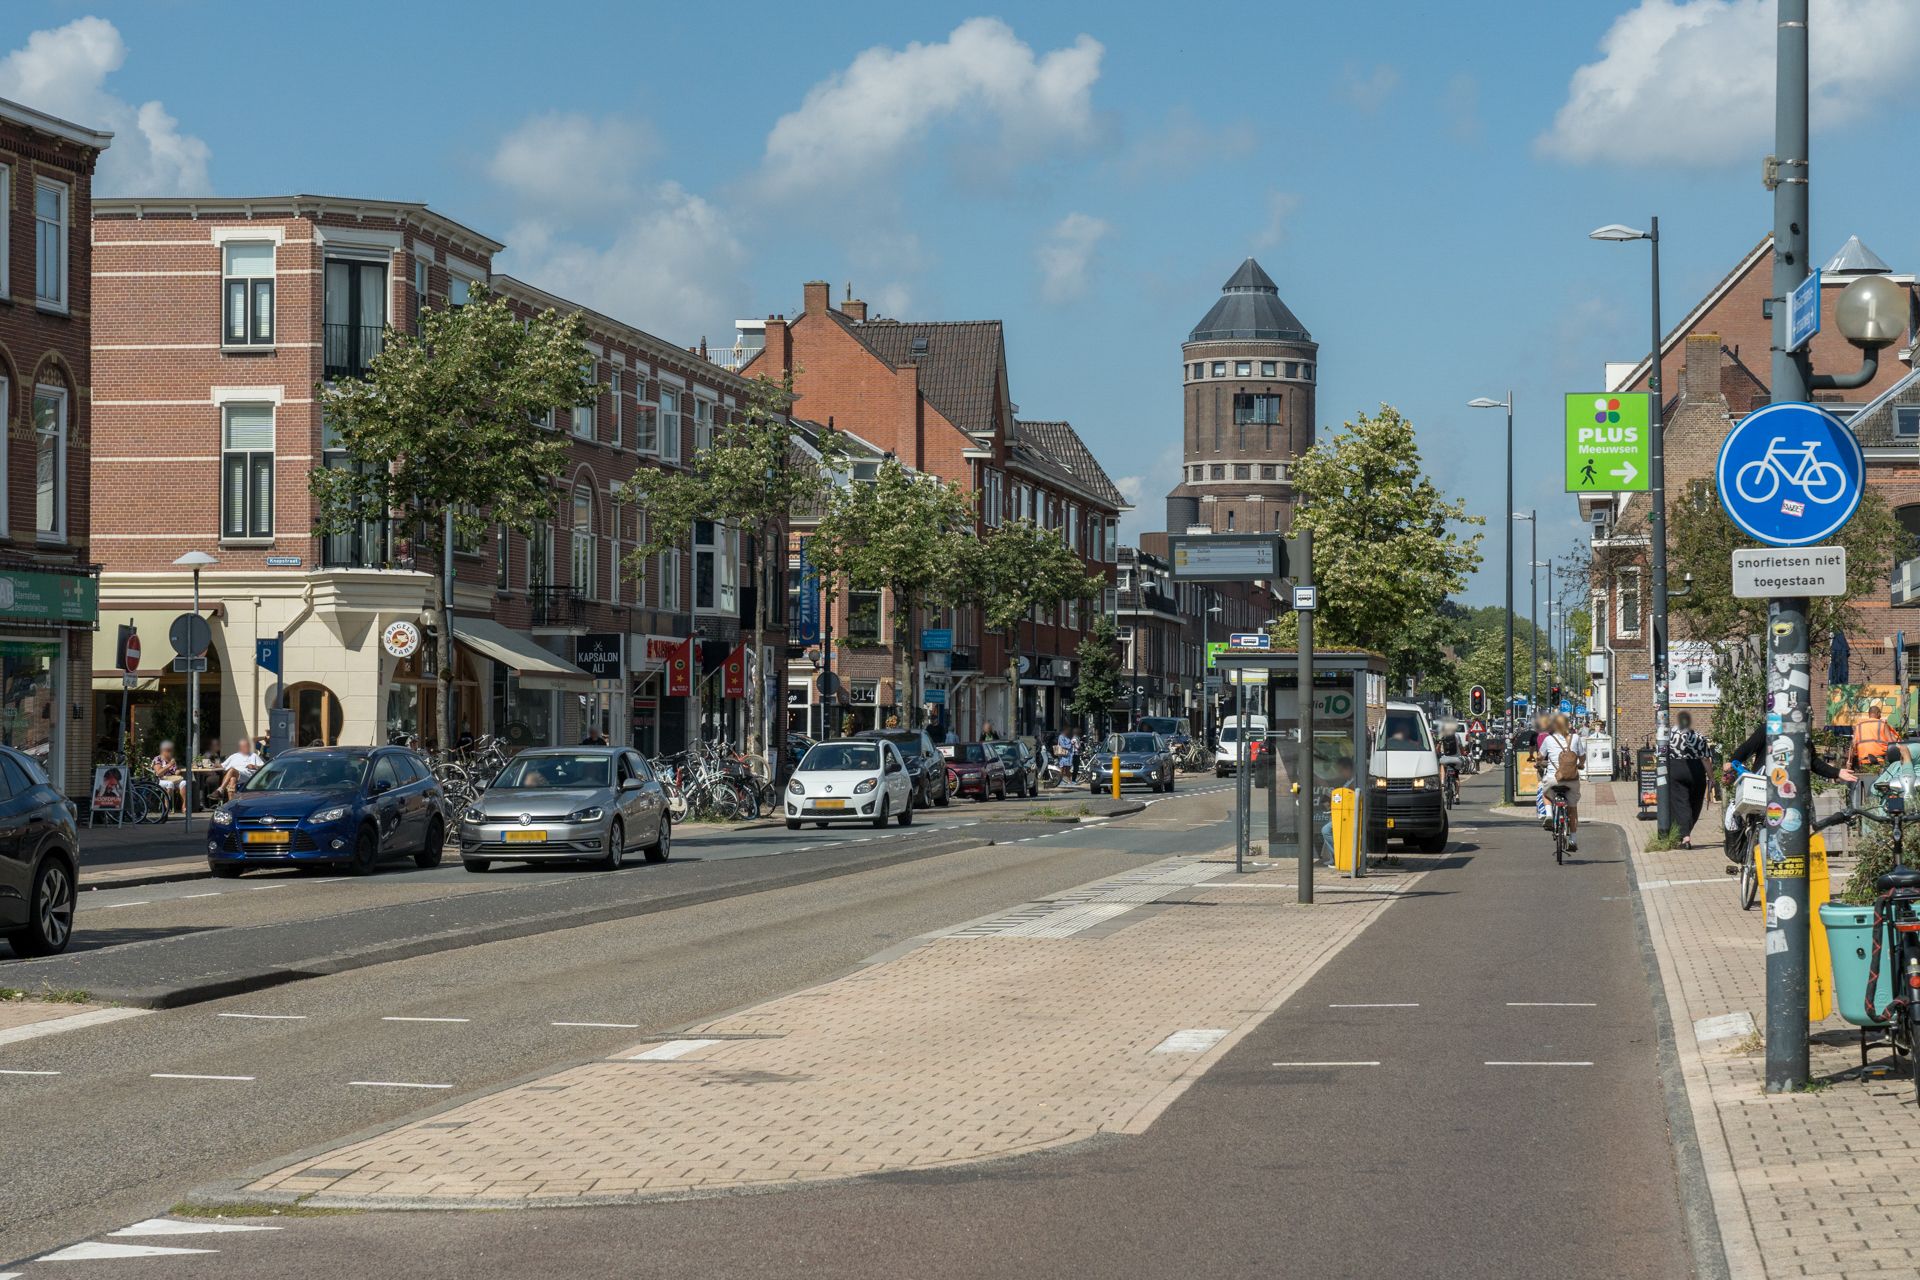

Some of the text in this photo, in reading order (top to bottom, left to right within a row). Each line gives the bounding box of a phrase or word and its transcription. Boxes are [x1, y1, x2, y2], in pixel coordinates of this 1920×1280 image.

[1578, 427, 1639, 443] PLUS
[1578, 444, 1639, 455] Meeuwsen
[1737, 555, 1841, 569] snorfietsen niet
[1753, 575, 1826, 589] toegestaan
[387, 623, 415, 636] BAGELS
[262, 648, 272, 662] P
[388, 645, 414, 655] BEANS
[578, 652, 619, 662] KAPSALON
[592, 663, 605, 673] ALI
[850, 686, 875, 701] 314
[1324, 694, 1351, 714] 10
